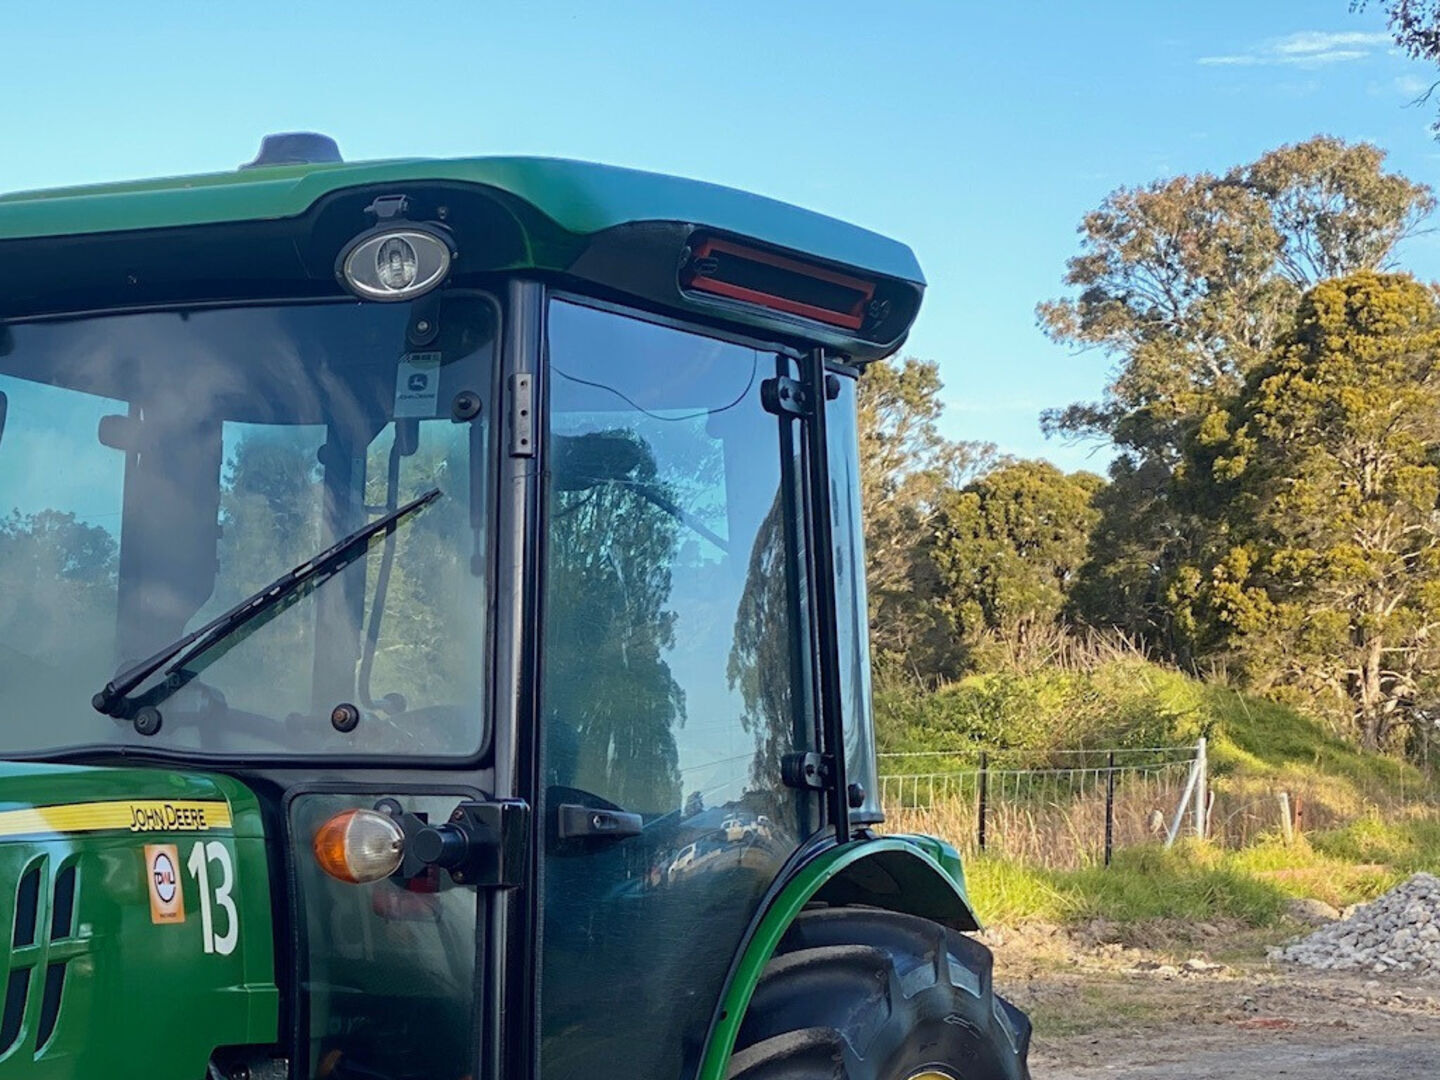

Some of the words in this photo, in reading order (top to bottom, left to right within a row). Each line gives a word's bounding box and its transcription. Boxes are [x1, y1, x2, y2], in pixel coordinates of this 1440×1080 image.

[130, 804, 165, 829] JOHN
[164, 803, 208, 829] DEERE
[187, 840, 239, 956] 13
